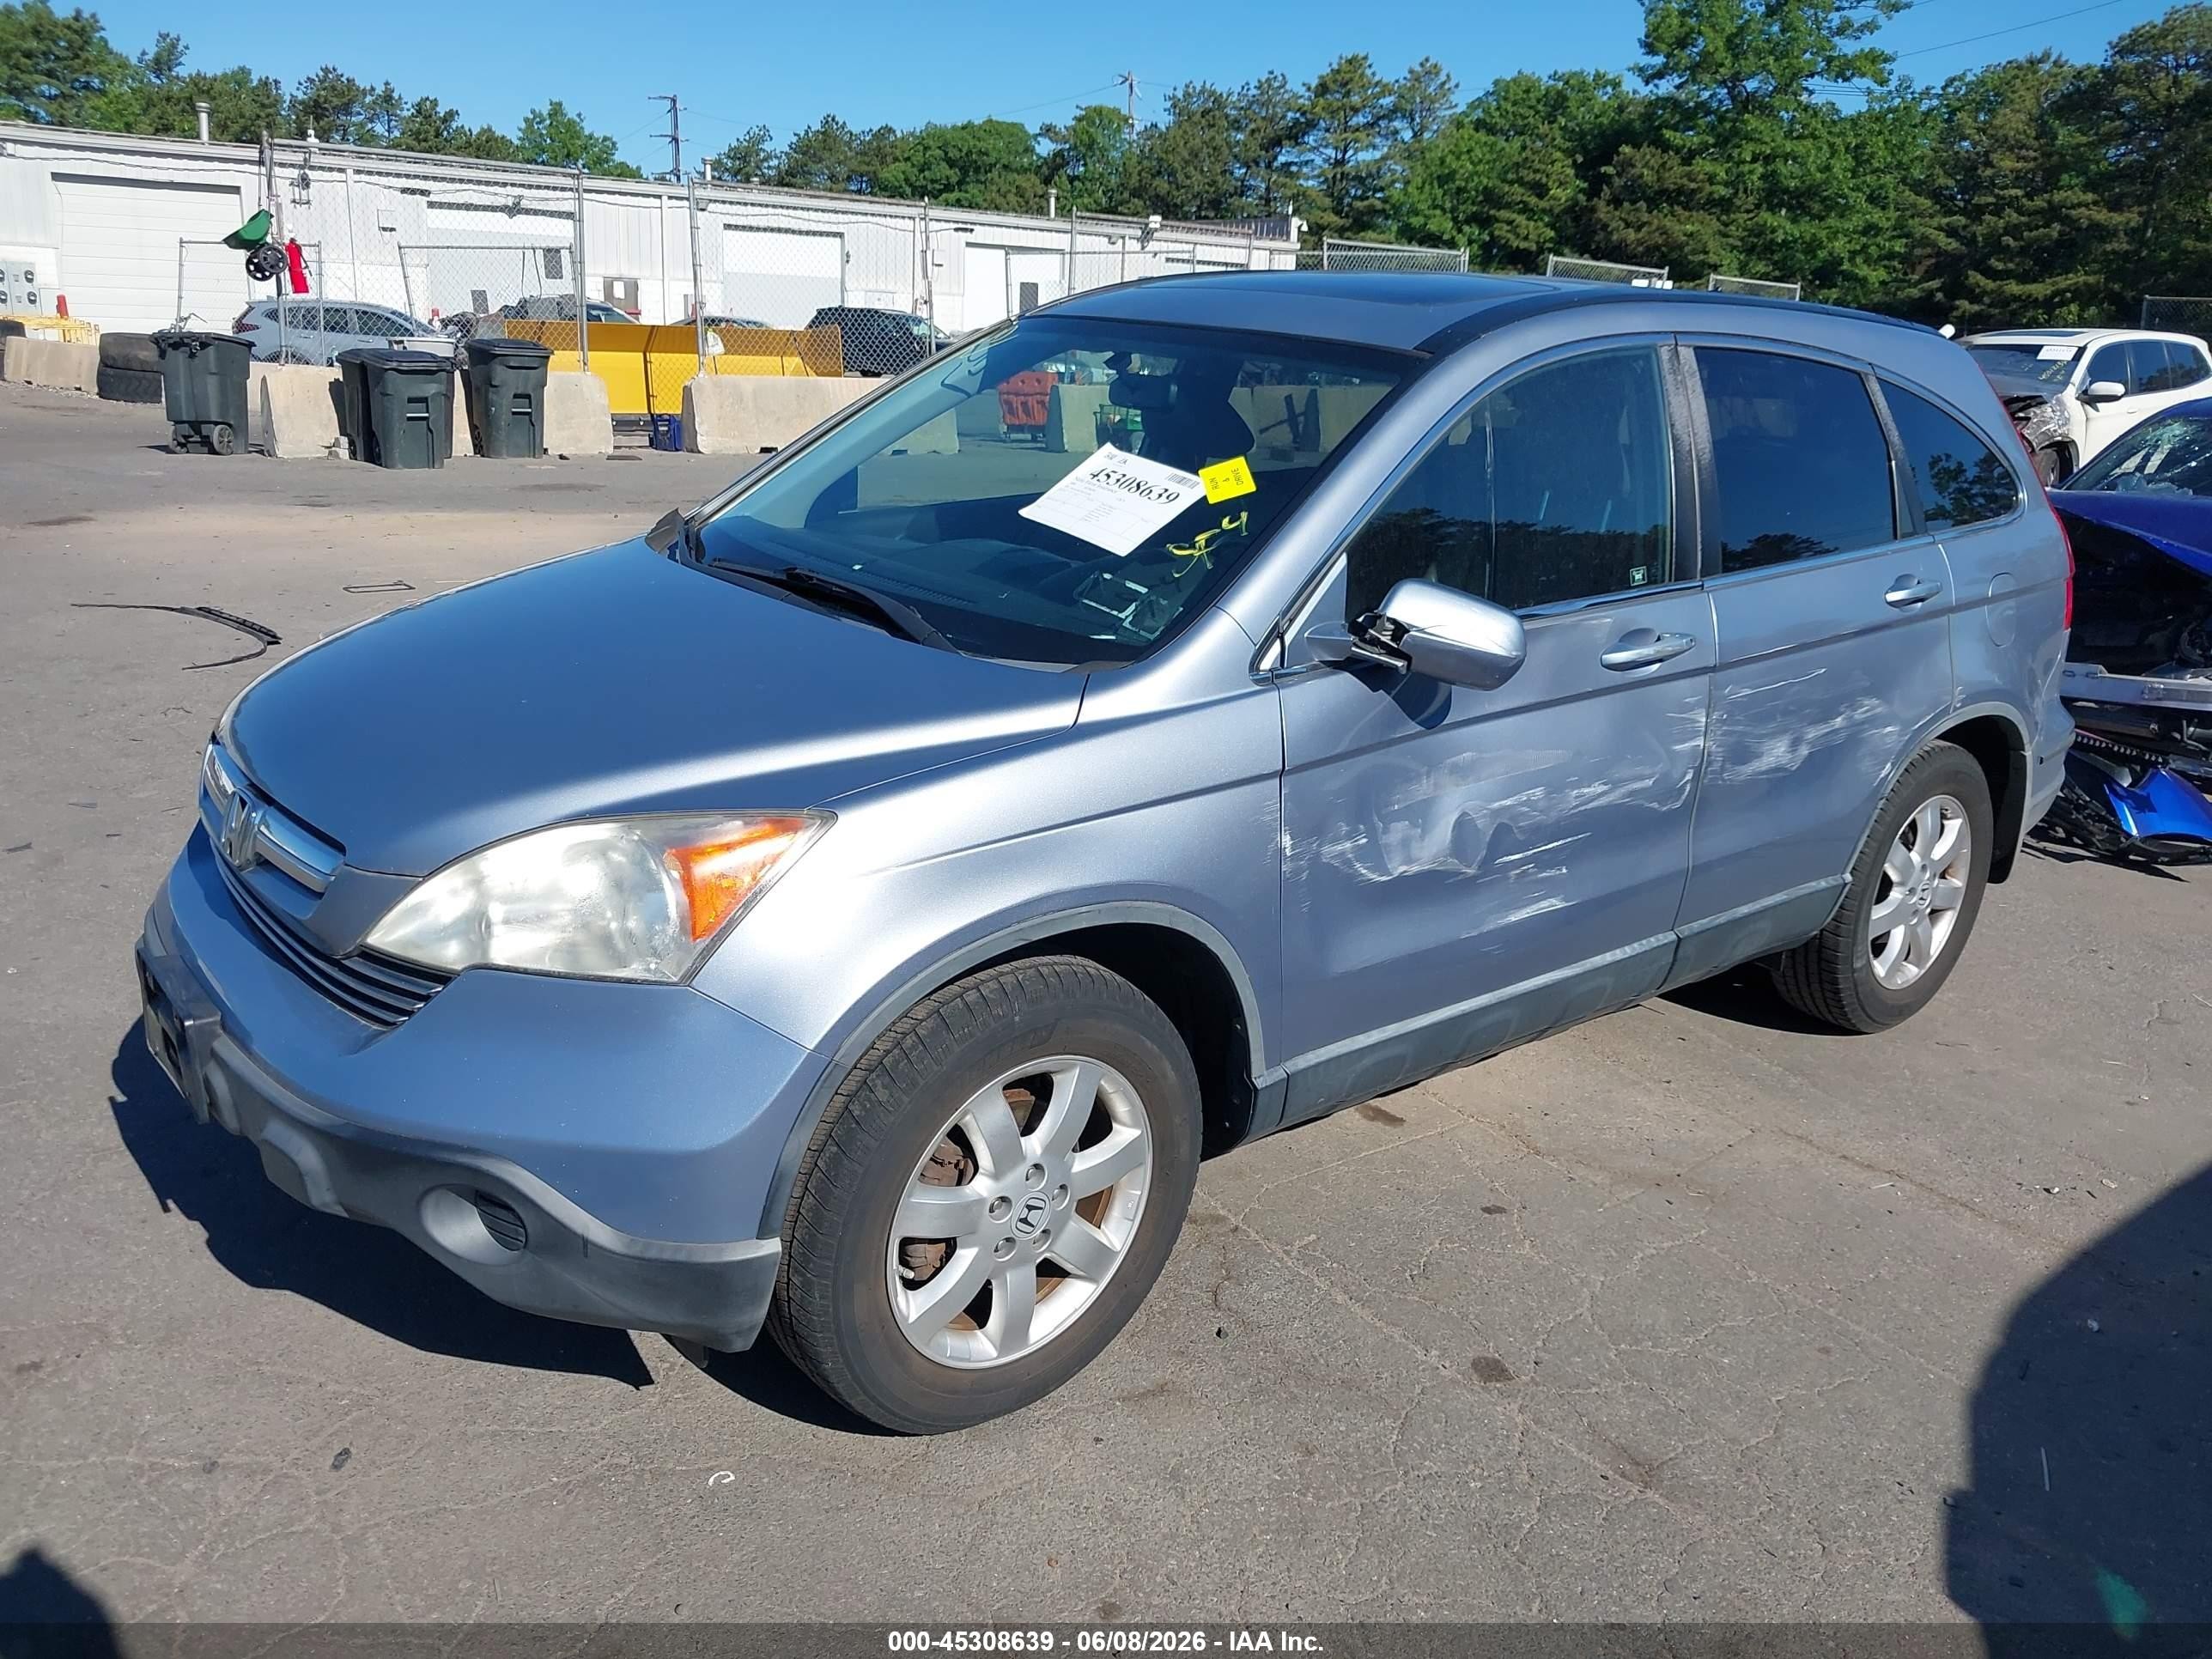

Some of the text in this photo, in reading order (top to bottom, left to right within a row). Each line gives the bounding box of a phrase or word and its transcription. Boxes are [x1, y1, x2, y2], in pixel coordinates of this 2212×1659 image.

[1089, 467, 1181, 505] 45308639
[1209, 477, 1220, 490] RUN
[1231, 467, 1244, 486] DRIVE
